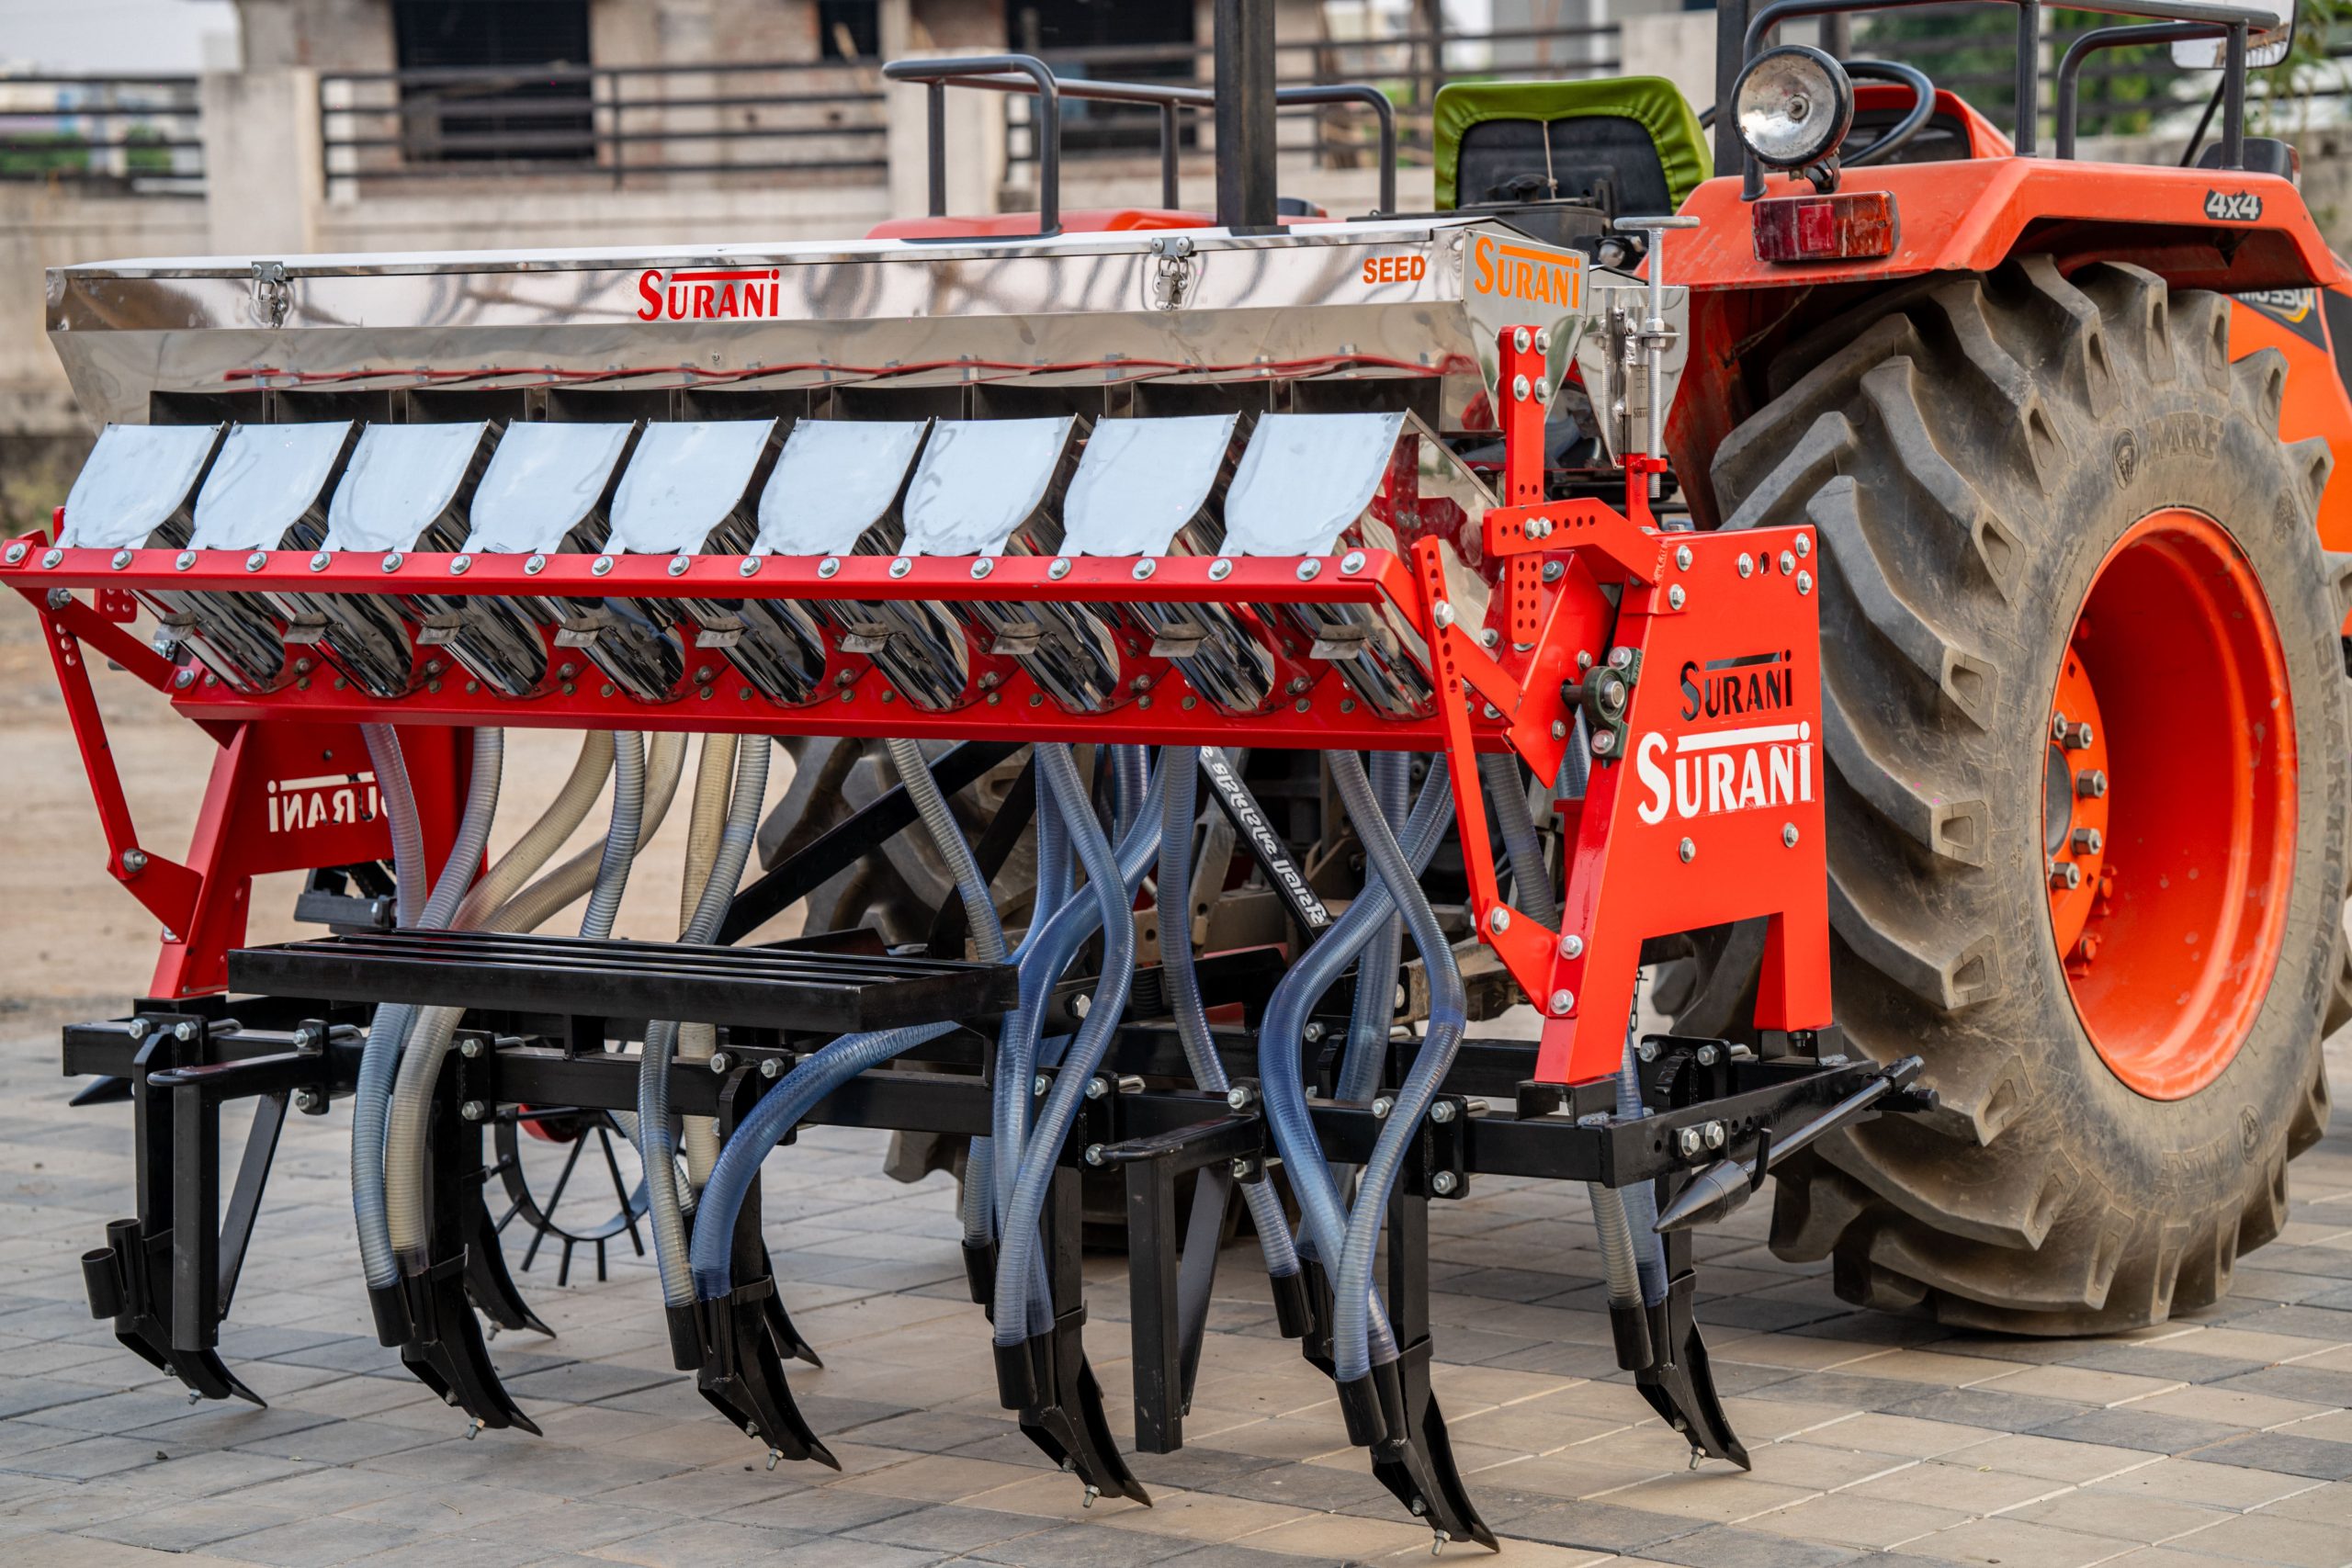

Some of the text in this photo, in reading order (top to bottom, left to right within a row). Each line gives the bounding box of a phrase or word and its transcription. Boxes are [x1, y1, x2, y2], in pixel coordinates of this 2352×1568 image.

[636, 269, 780, 321] SURANI
[1363, 255, 1426, 284] SEED
[1474, 237, 1580, 310] SURANI
[1680, 649, 1793, 722] SURANI
[1636, 721, 1814, 825] SURANI
